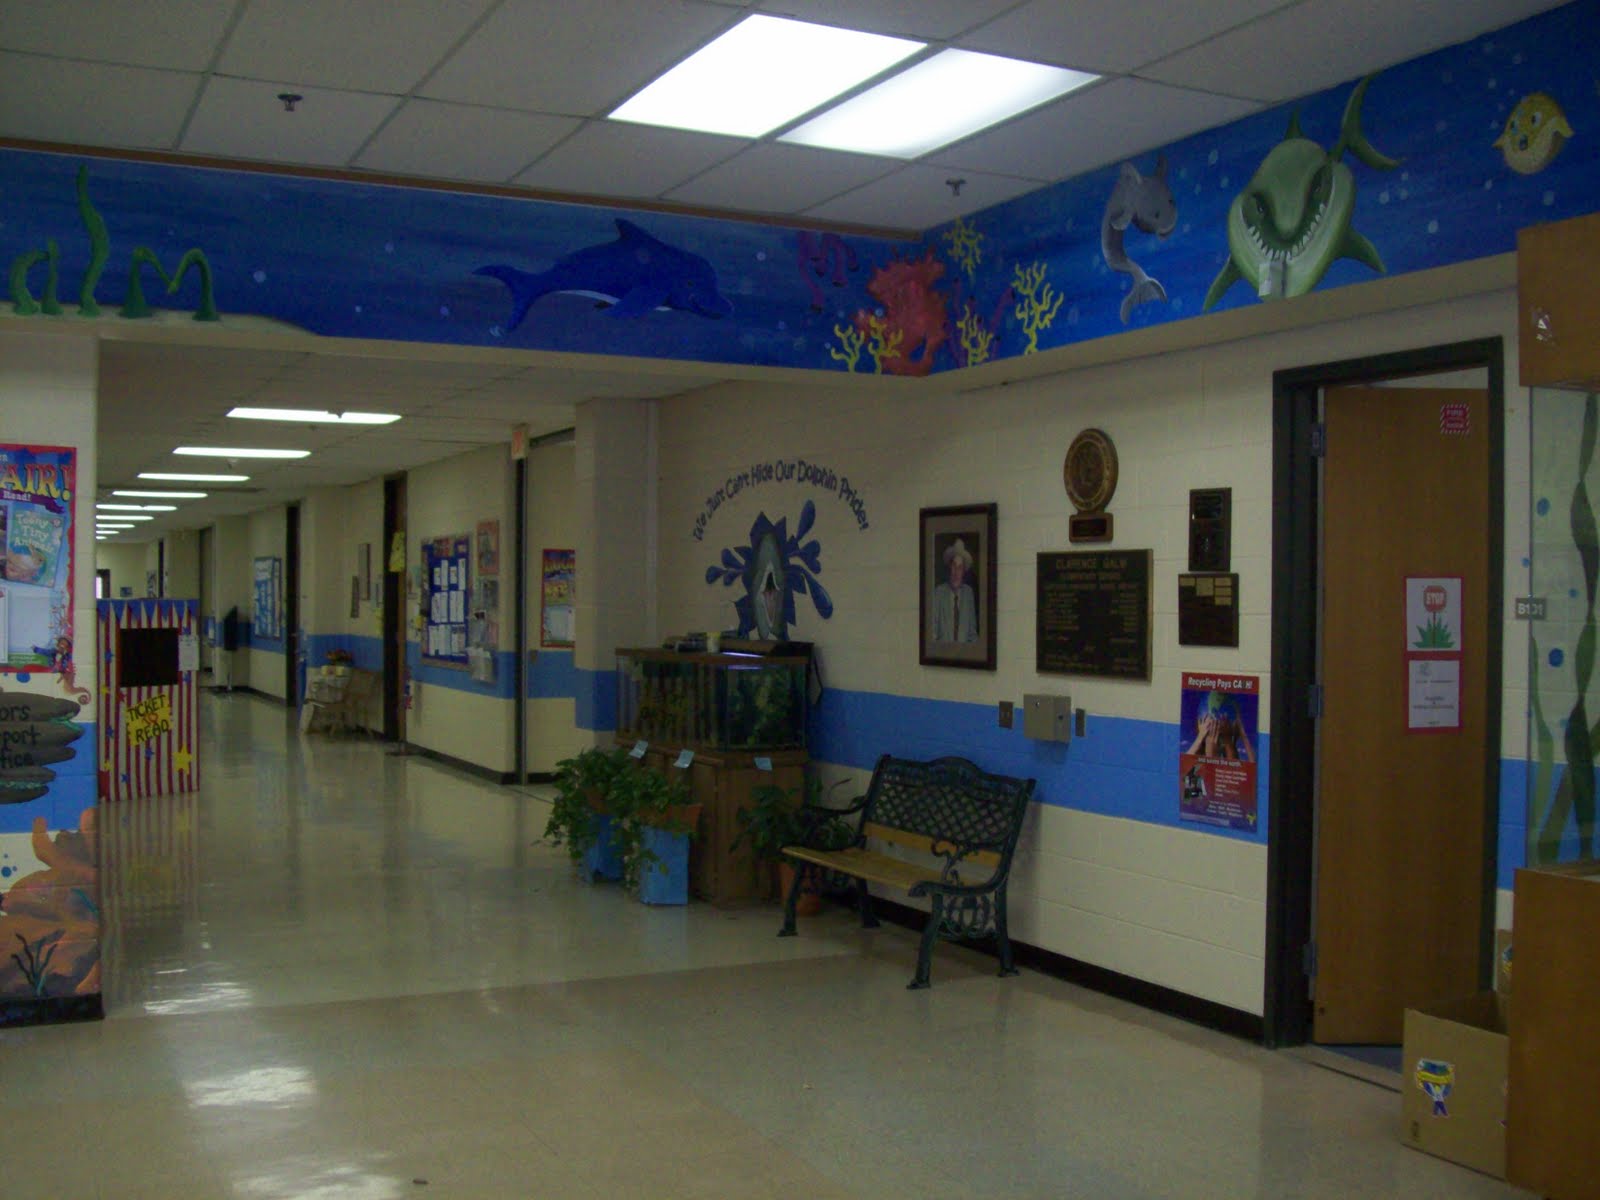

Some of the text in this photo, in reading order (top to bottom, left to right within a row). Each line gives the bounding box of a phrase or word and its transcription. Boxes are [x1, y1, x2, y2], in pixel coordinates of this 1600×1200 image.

[751, 463, 774, 487] Hide
[775, 460, 796, 482] Our
[797, 460, 838, 491] Dolphin
[1426, 592, 1444, 605] STOP
[1188, 677, 1217, 689] Recycling
[1217, 679, 1232, 690] Pays
[127, 694, 166, 722] TICKET
[135, 719, 170, 743] READ
